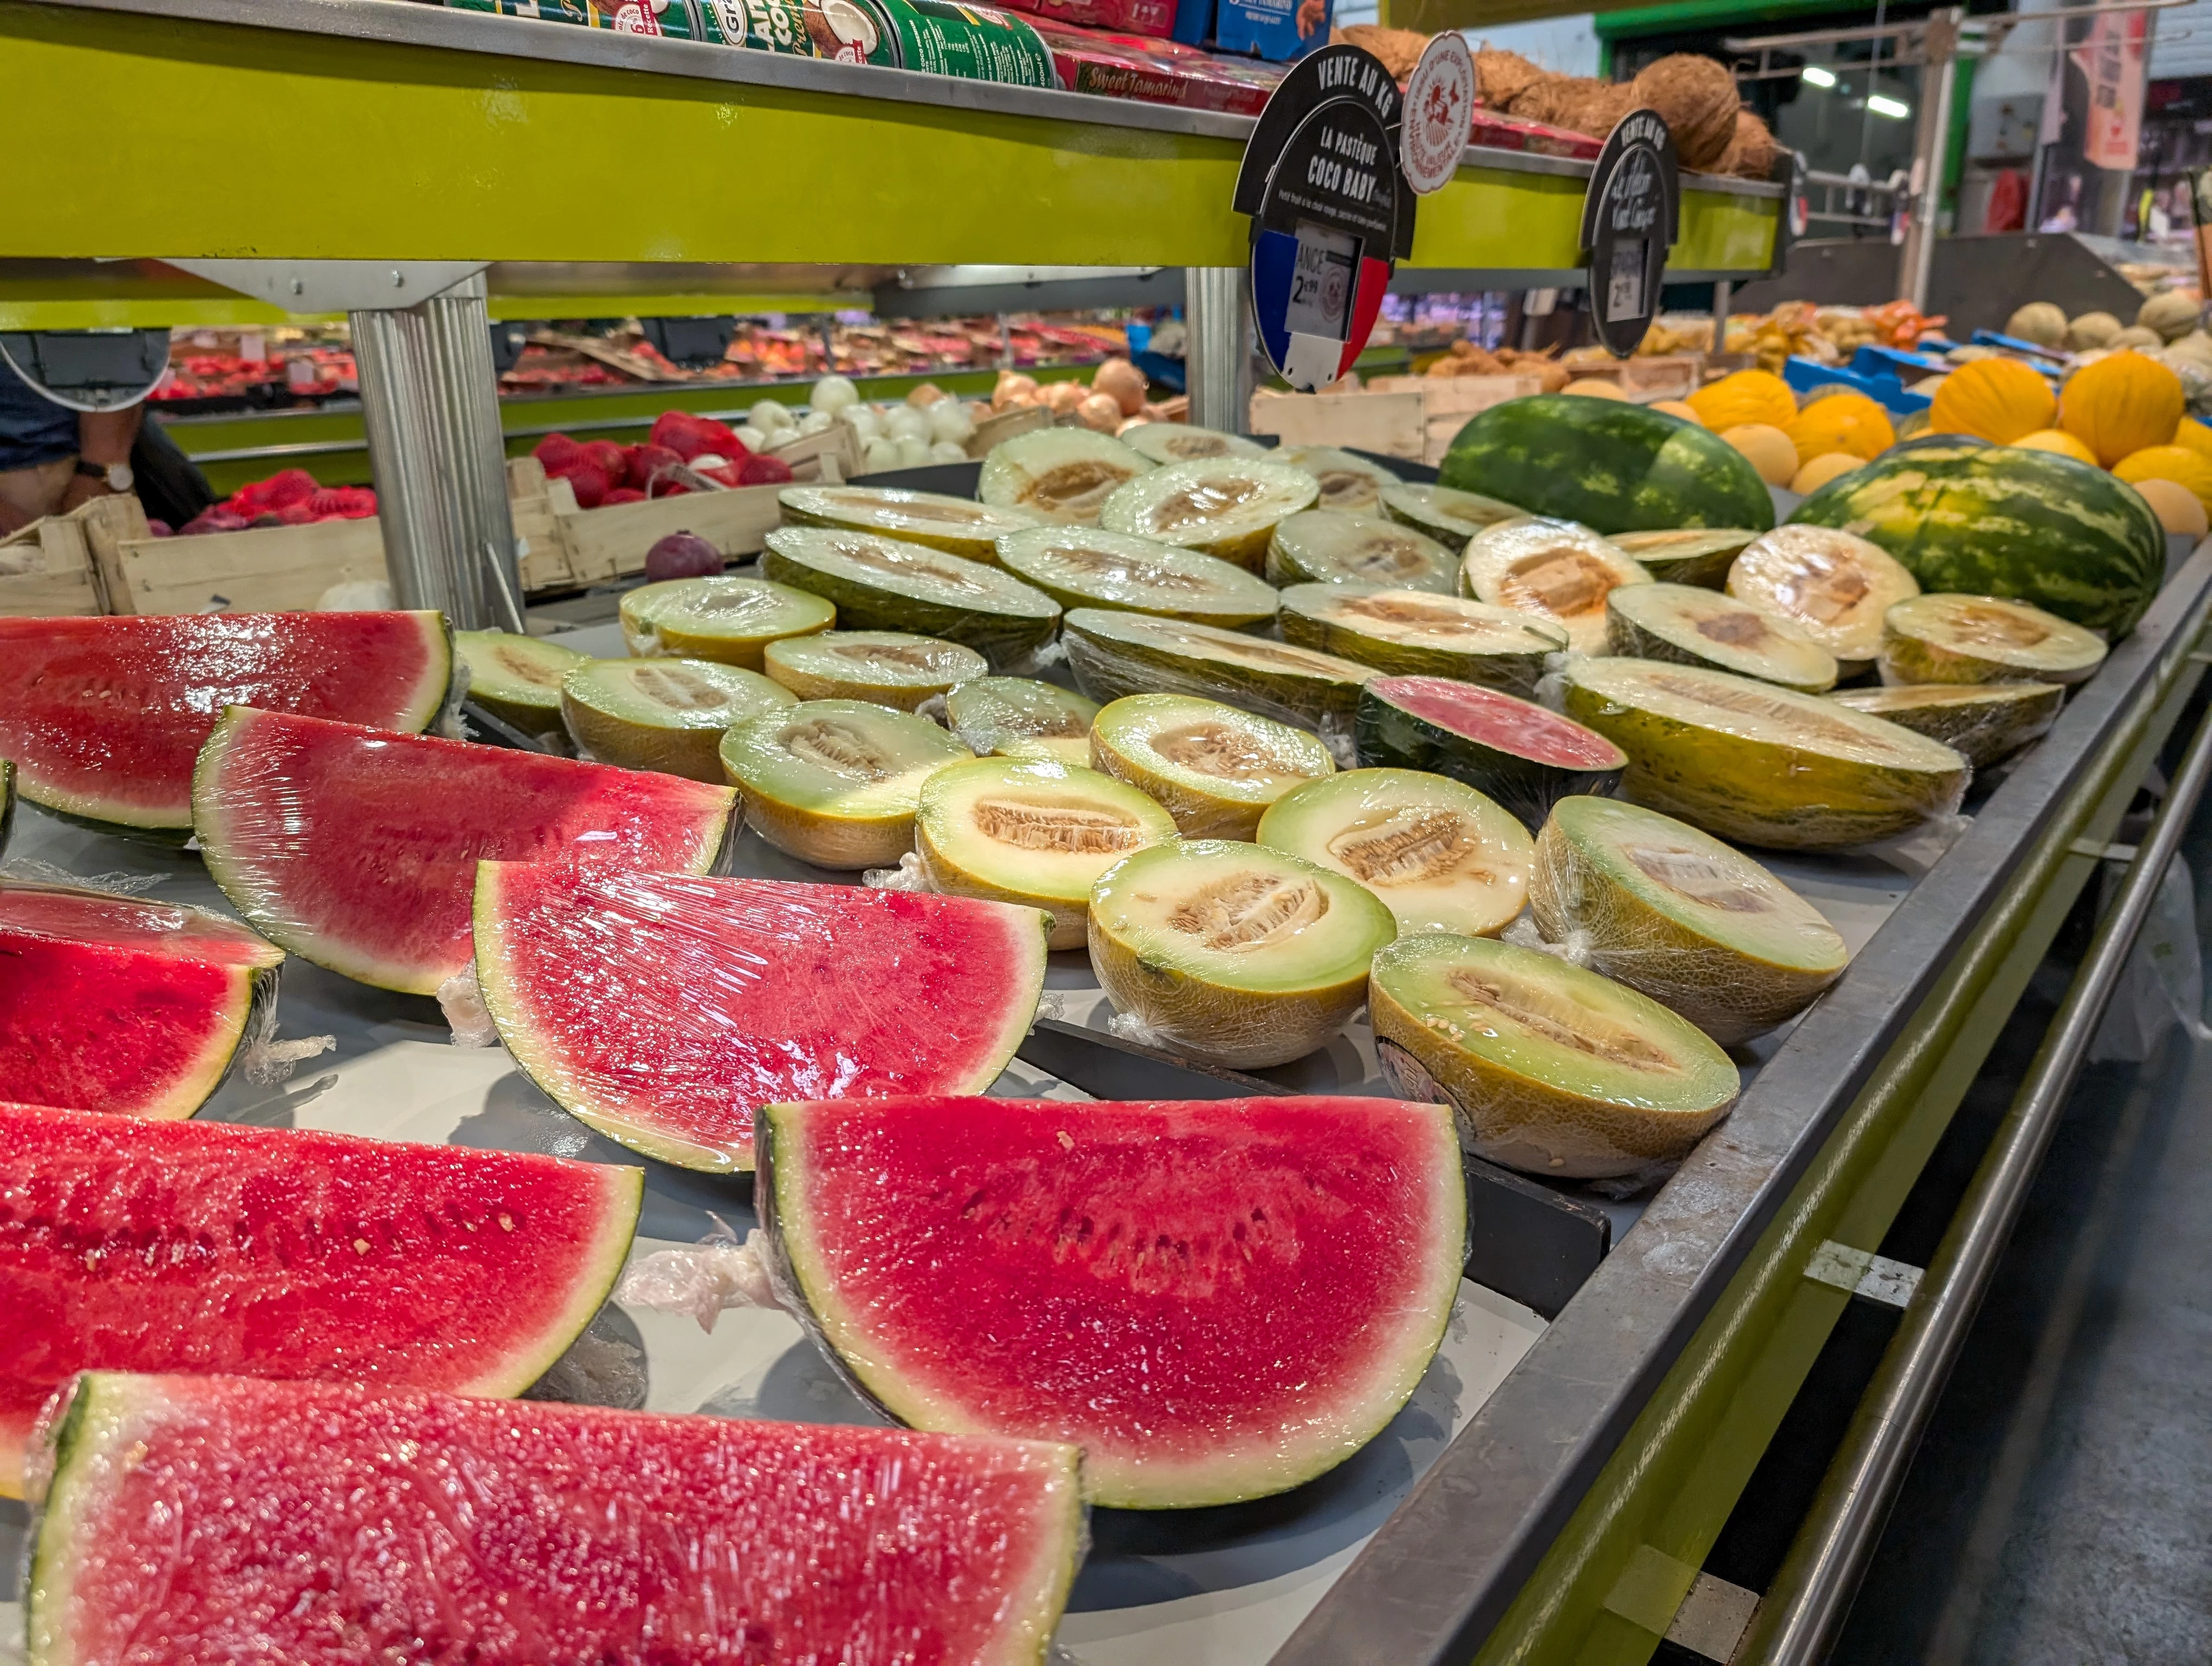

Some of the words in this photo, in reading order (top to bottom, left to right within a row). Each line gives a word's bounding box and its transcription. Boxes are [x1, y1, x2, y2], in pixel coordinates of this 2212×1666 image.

[627, 9, 639, 17] coco
[643, 4, 654, 33] Recette
[706, 4, 726, 45] QUALITY
[909, 20, 922, 48] PREMIUM
[1037, 62, 1045, 87] 400ml
[1089, 67, 1128, 92] Sweet
[1129, 73, 1189, 100] Tamarind
[1318, 56, 1359, 91] VENTE
[1358, 63, 1379, 97] AU
[1375, 81, 1394, 119] KG
[1320, 126, 1334, 149] LA
[1335, 132, 1378, 166] PASTÈQUE
[1307, 155, 1342, 191] COCO
[1342, 168, 1378, 203] BABY
